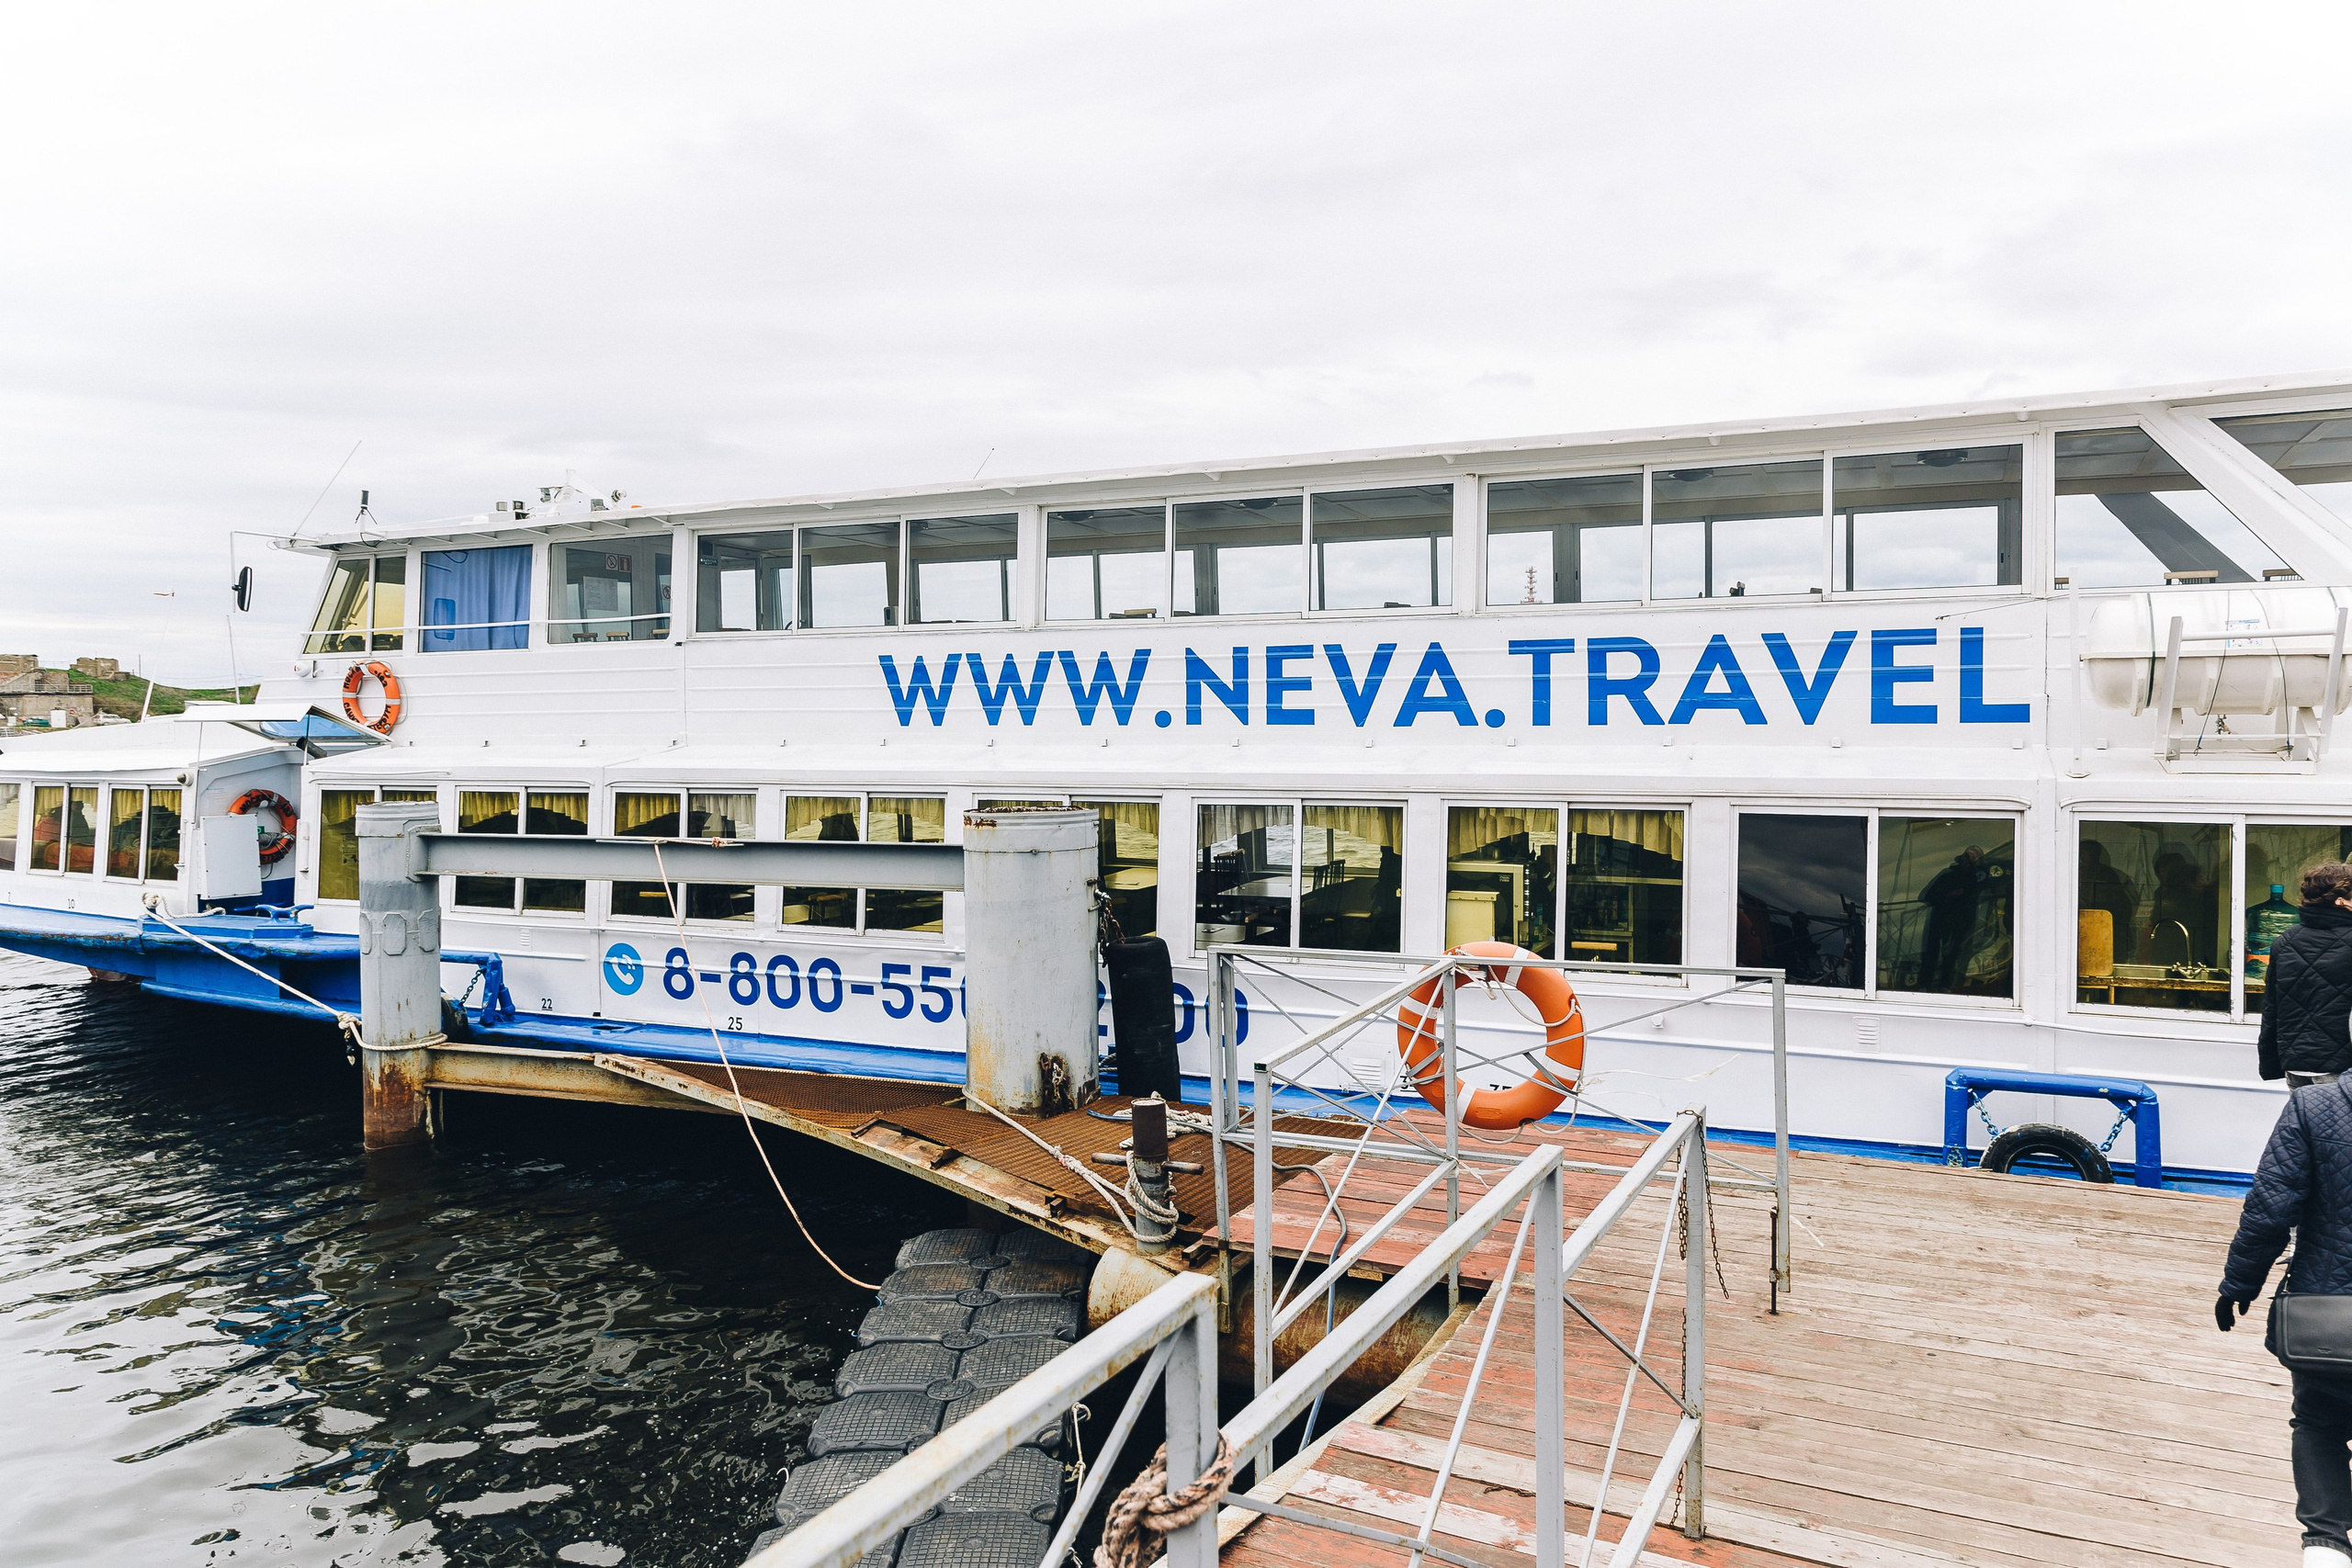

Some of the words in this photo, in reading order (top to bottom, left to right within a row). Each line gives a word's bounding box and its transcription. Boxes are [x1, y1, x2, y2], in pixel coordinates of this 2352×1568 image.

[878, 626, 2031, 728] WWW.NEVA.TRAVEL
[541, 998, 553, 1010] 22
[727, 1016, 743, 1031] 25
